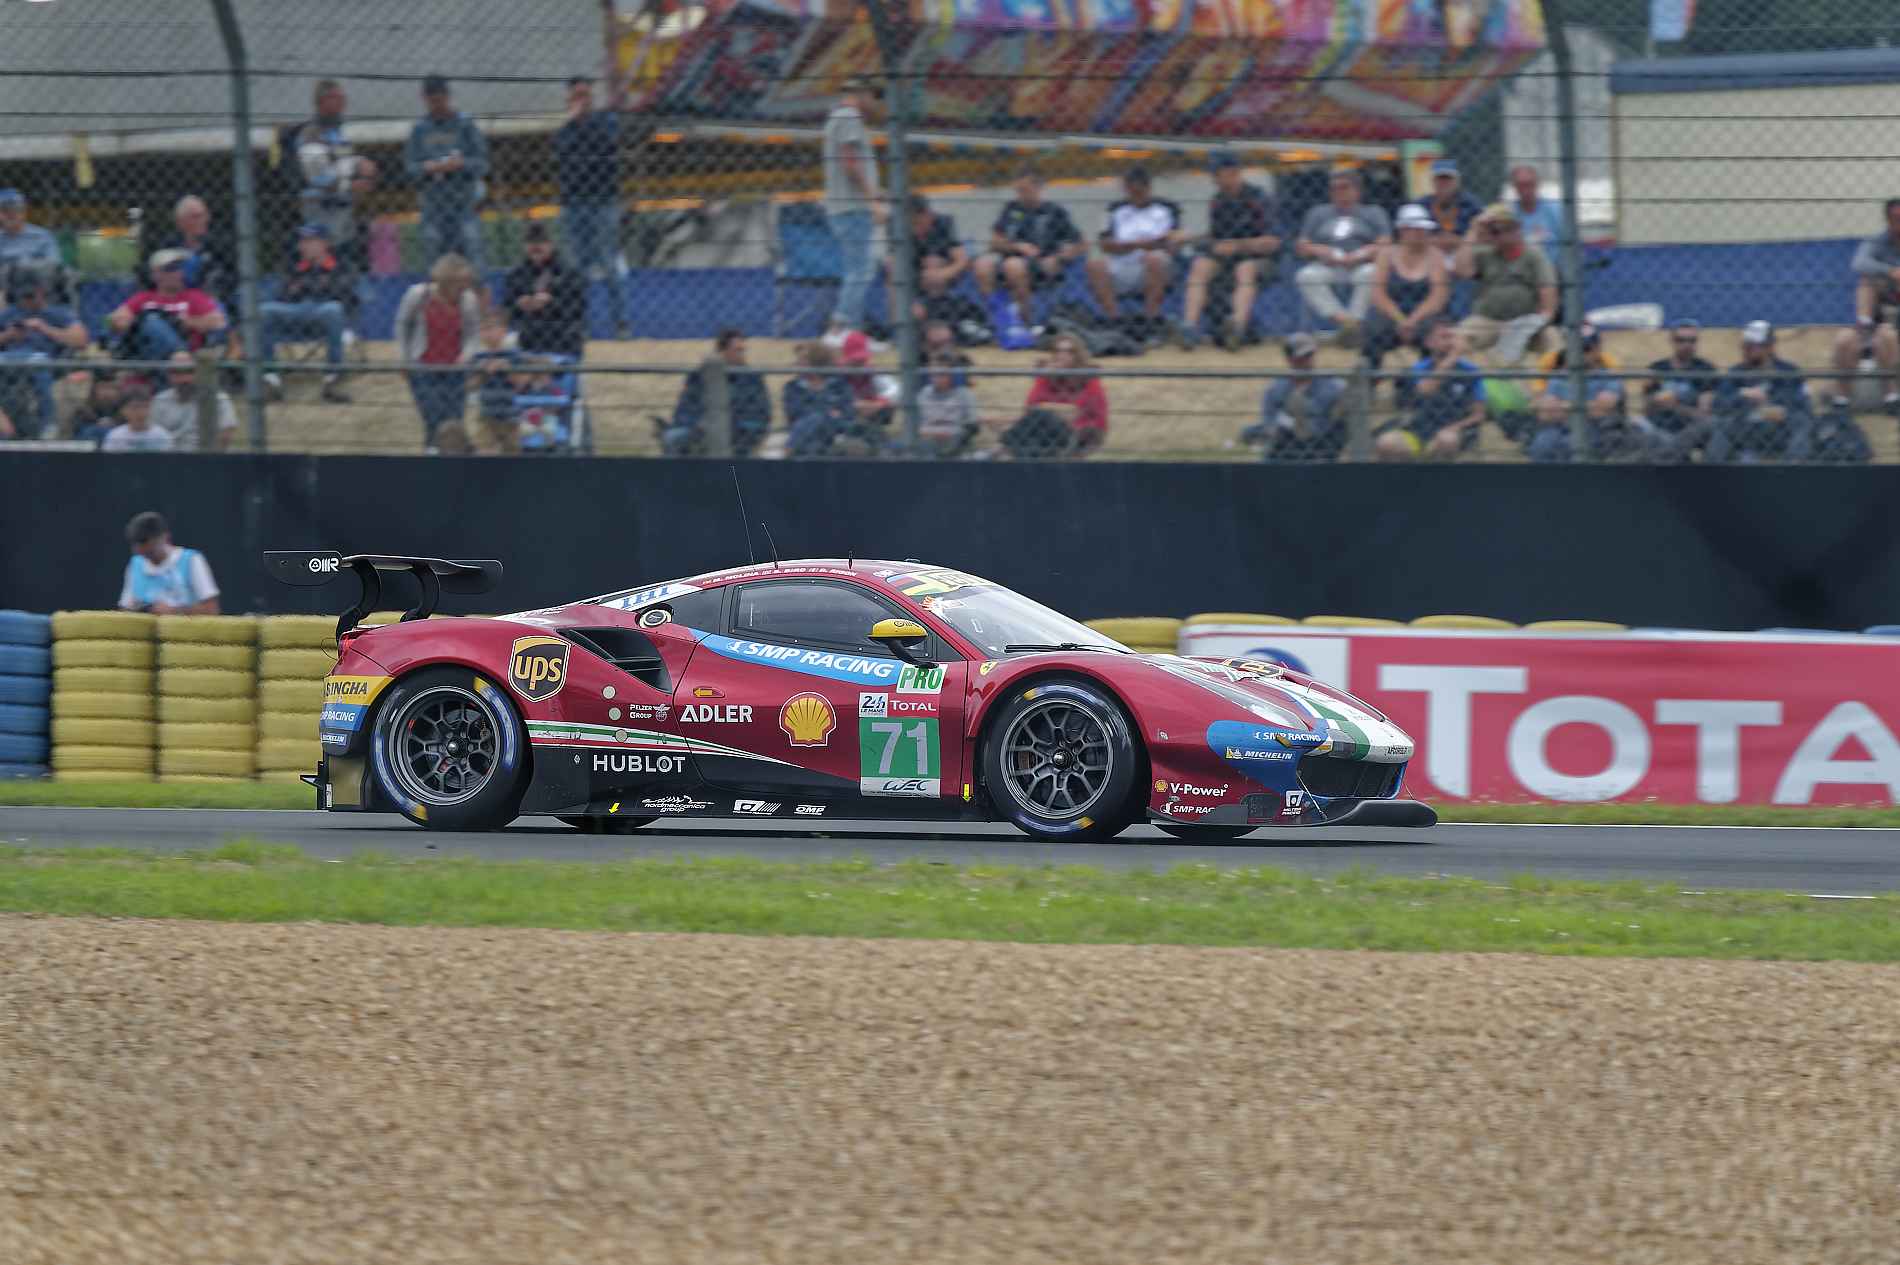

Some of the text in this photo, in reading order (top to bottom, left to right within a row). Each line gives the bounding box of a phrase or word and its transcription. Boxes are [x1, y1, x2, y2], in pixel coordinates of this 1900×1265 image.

[744, 641, 893, 677] SMP RACING
[899, 666, 943, 690] PRO
[325, 681, 368, 696] SINGHA
[680, 704, 753, 722] ADLER
[889, 700, 937, 711] TOTAL
[871, 721, 929, 775] 71
[1244, 750, 1293, 760] MICHELIN
[593, 754, 686, 773] HUBLOT
[1170, 782, 1227, 797] V-Power
[795, 805, 826, 814] OMP
[1173, 805, 1194, 813] SMP
